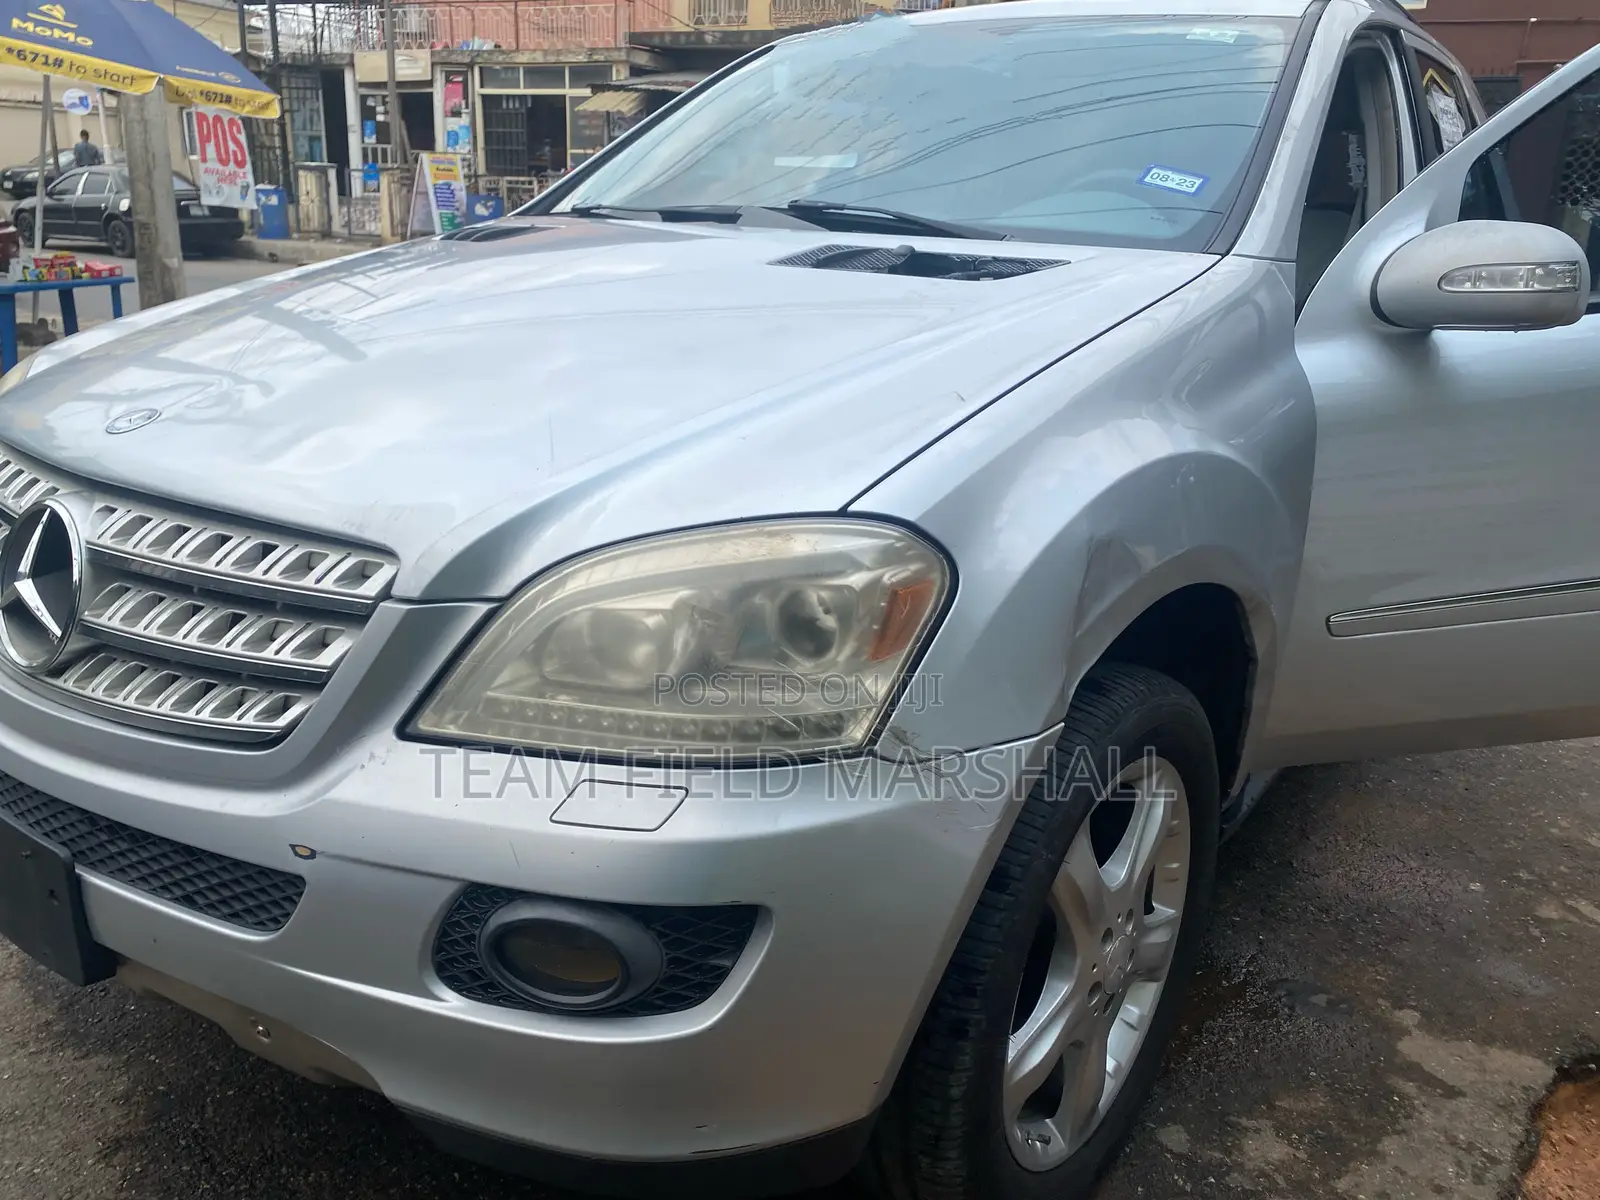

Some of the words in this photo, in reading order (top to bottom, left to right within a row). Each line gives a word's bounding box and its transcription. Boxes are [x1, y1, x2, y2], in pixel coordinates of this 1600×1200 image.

[11, 17, 94, 46] MoMo
[68, 60, 87, 75] to
[92, 66, 137, 87] start
[195, 111, 247, 169] POS
[1150, 172, 1170, 182] 08
[1175, 178, 1197, 189] 23
